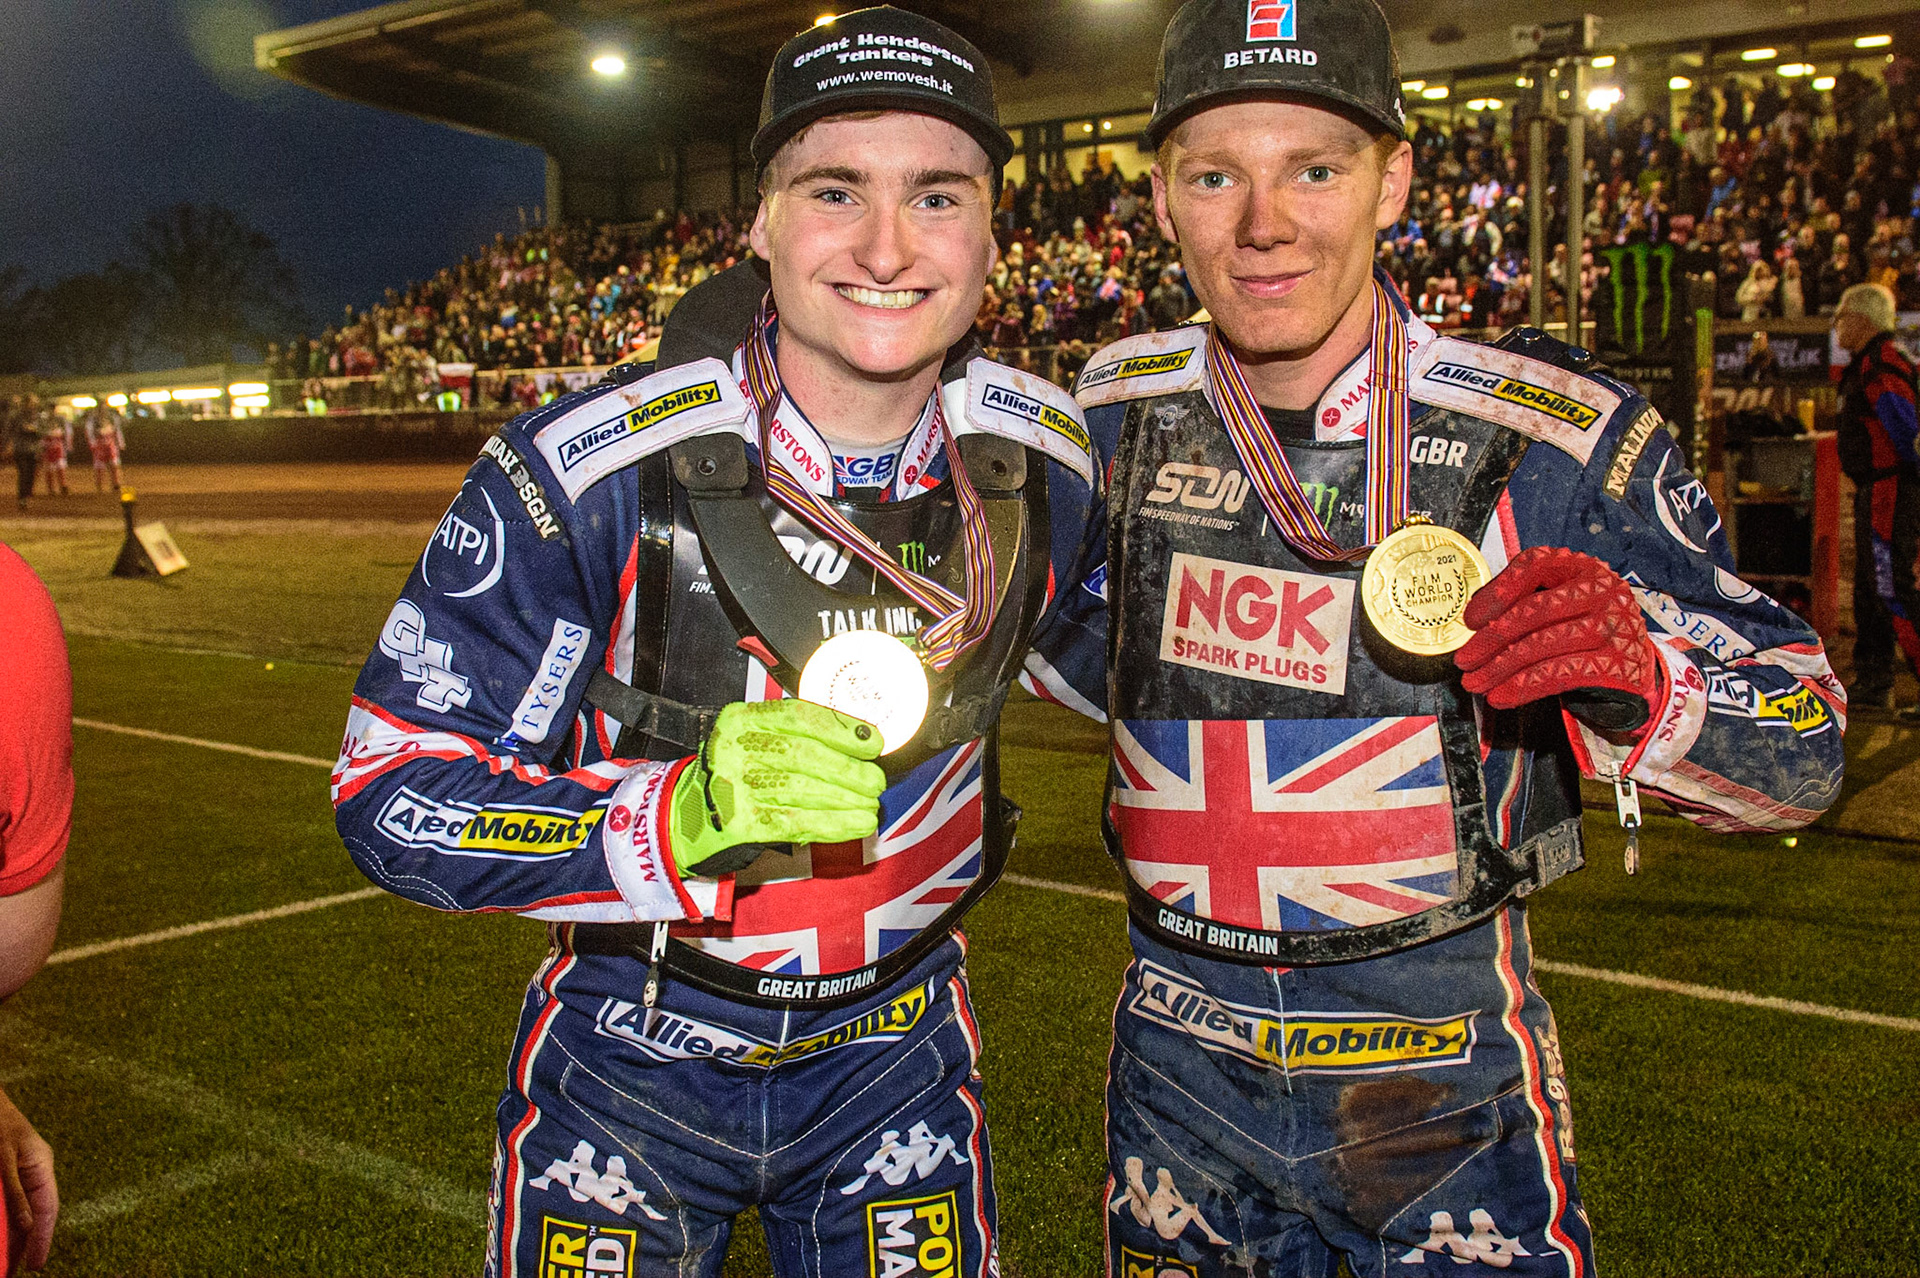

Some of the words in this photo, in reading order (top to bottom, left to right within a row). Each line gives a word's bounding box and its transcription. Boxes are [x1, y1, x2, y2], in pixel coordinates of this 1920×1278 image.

[793, 37, 850, 68] Grant
[857, 33, 974, 73] Henderson
[836, 47, 934, 67] Tankers
[1223, 47, 1318, 69] BETARD
[816, 70, 953, 95] www.wemovesh.it
[1080, 363, 1120, 386] Allied
[1121, 351, 1190, 374] Mobility
[1432, 365, 1501, 389] Allied
[1501, 379, 1594, 424] Mobility
[564, 418, 628, 462] Allied
[630, 382, 716, 426] Mobility
[986, 391, 1041, 417] Allied
[1042, 408, 1090, 450] Mobility
[1410, 435, 1469, 468] GBR
[1138, 506, 1153, 517] FIM
[1151, 508, 1191, 524] SPEEDWAY
[1189, 514, 1201, 525] OF
[435, 512, 489, 566] ATPI
[1436, 554, 1457, 565] 2021
[1175, 563, 1336, 656] NGK
[1404, 582, 1453, 599] WORLD
[1406, 594, 1454, 608] CHAMPION
[521, 624, 583, 730] TYSERS
[1172, 638, 1240, 670] SPARK
[1245, 647, 1328, 685] PLUGS
[1157, 908, 1206, 943] GREAT
[1206, 924, 1279, 956] BRITAIN
[757, 976, 815, 1000] GREAT
[817, 967, 877, 999] BRITAIN
[611, 1005, 750, 1059] Allied
[1150, 980, 1253, 1043] Allied
[1264, 1025, 1464, 1060] Mobility
